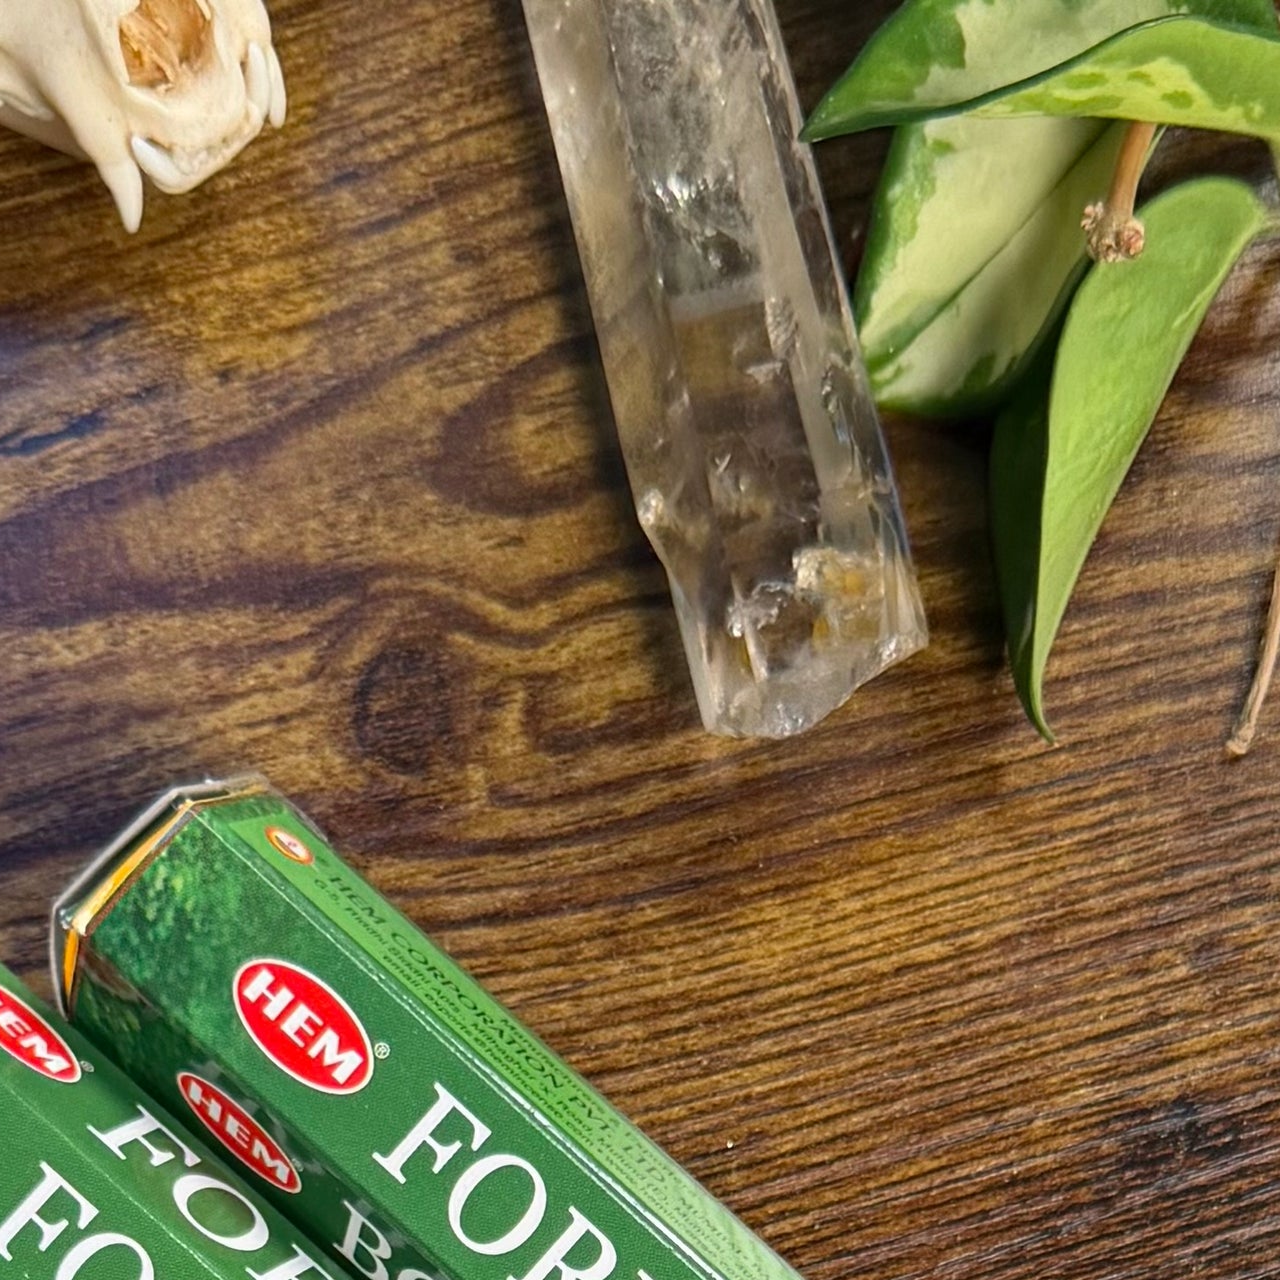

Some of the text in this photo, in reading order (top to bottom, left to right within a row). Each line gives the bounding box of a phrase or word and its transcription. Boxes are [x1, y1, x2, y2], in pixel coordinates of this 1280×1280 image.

[241, 968, 364, 1085] HEM
[329, 876, 385, 924] HEM
[390, 927, 564, 1091] CORPORATION
[187, 1080, 291, 1186] HEM
